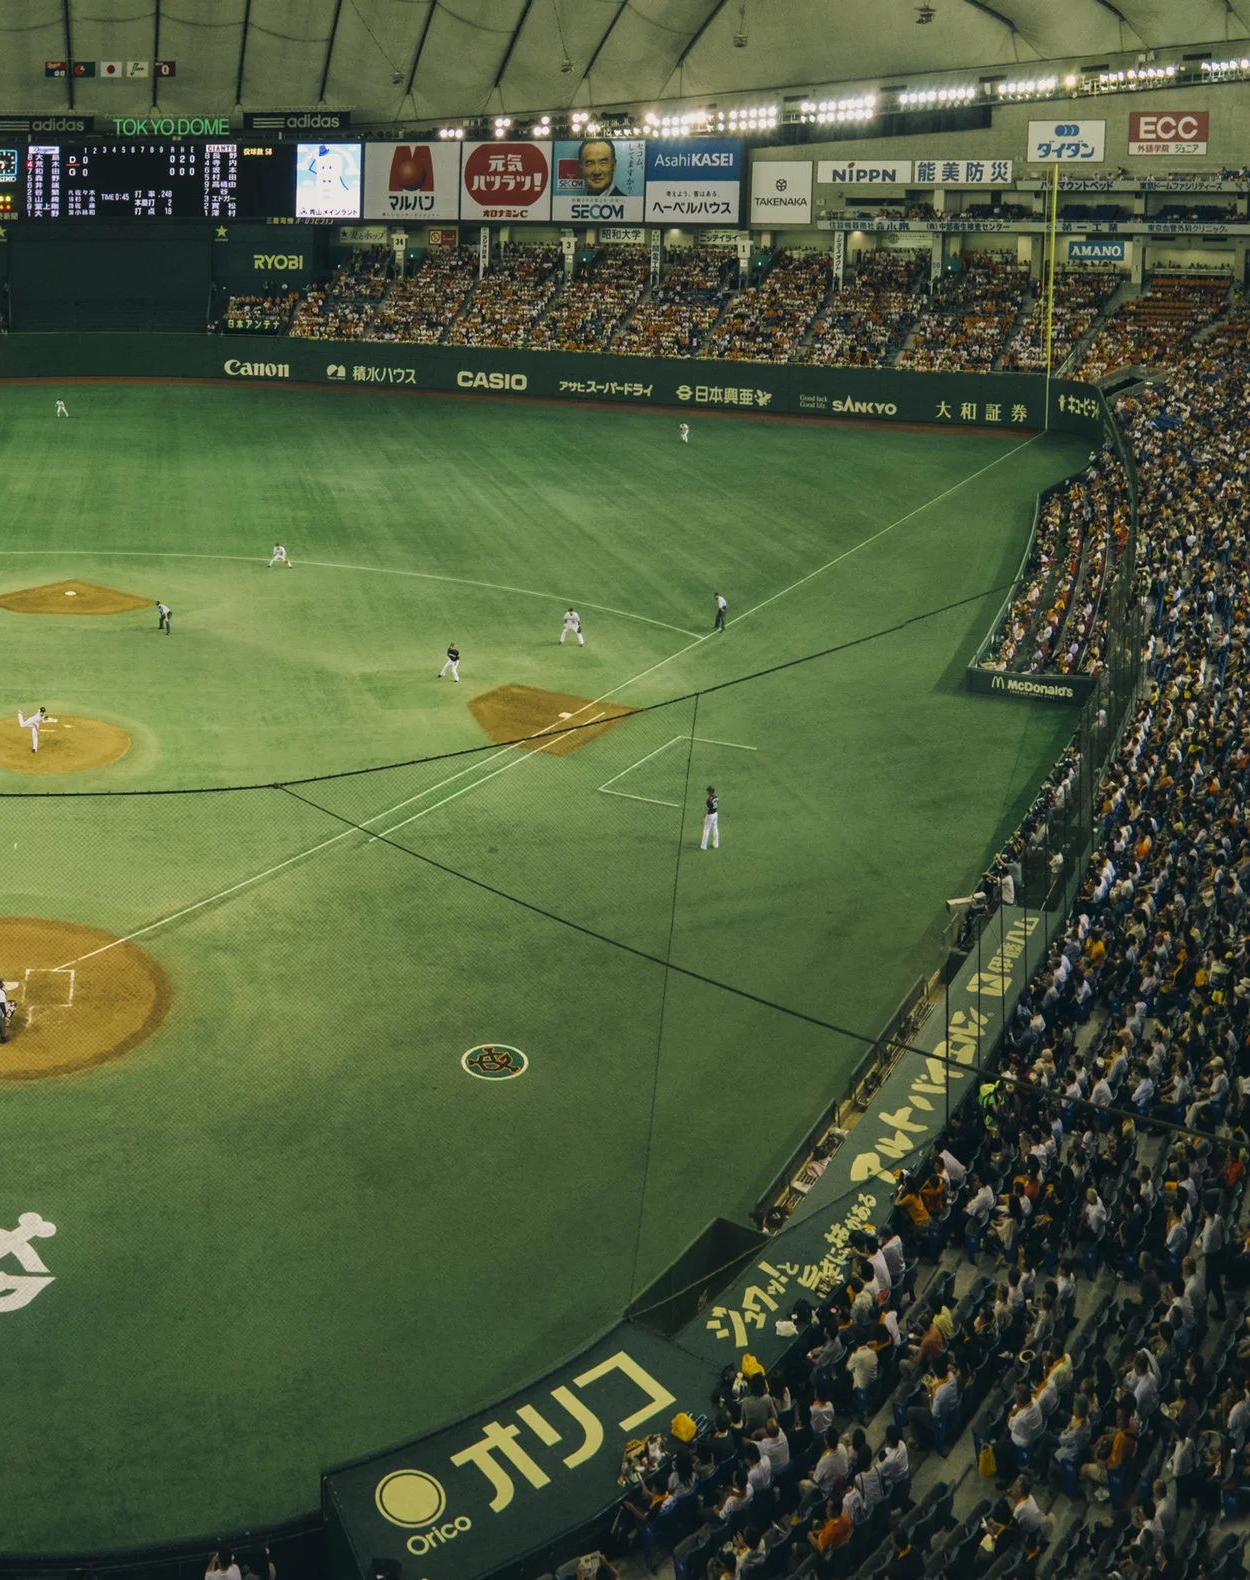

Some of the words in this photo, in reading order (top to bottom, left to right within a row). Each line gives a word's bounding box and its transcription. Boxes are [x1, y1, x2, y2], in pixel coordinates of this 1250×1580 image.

[32, 118, 85, 132] adidas
[113, 118, 174, 136] TOKYO
[177, 118, 230, 136] DOME
[286, 113, 341, 129] adidas
[1139, 116, 1198, 140] ECC
[1037, 140, 1095, 159] ダイダン
[1137, 144, 1169, 153] 外語学院
[489, 154, 523, 172] 元気
[917, 161, 1009, 182] 能美防災
[1040, 181, 1114, 190] パマウントベッド
[388, 195, 435, 211] マルハン
[652, 201, 732, 215] ヘーベルハウス
[754, 197, 808, 207] TAKENAKA
[483, 209, 528, 218] オロナミンC
[571, 204, 624, 220] SECOM
[601, 229, 641, 240] 昭和大学
[1071, 245, 1121, 257] AMANO
[253, 254, 303, 270] RYOBI
[228, 319, 280, 331] 日本アンテナ
[223, 359, 290, 378] Canon
[352, 365, 417, 385] 積水ハウス
[456, 371, 528, 391] CASIO
[558, 380, 654, 398] アサヒスーパードライ
[695, 385, 754, 406] 日本興亜
[831, 395, 897, 416] SANKYO
[935, 400, 1028, 423] 大和証券
[1007, 679, 1074, 698] McDonald's
[449, 1350, 678, 1514] オリコ
[405, 1515, 473, 1557] Orico
